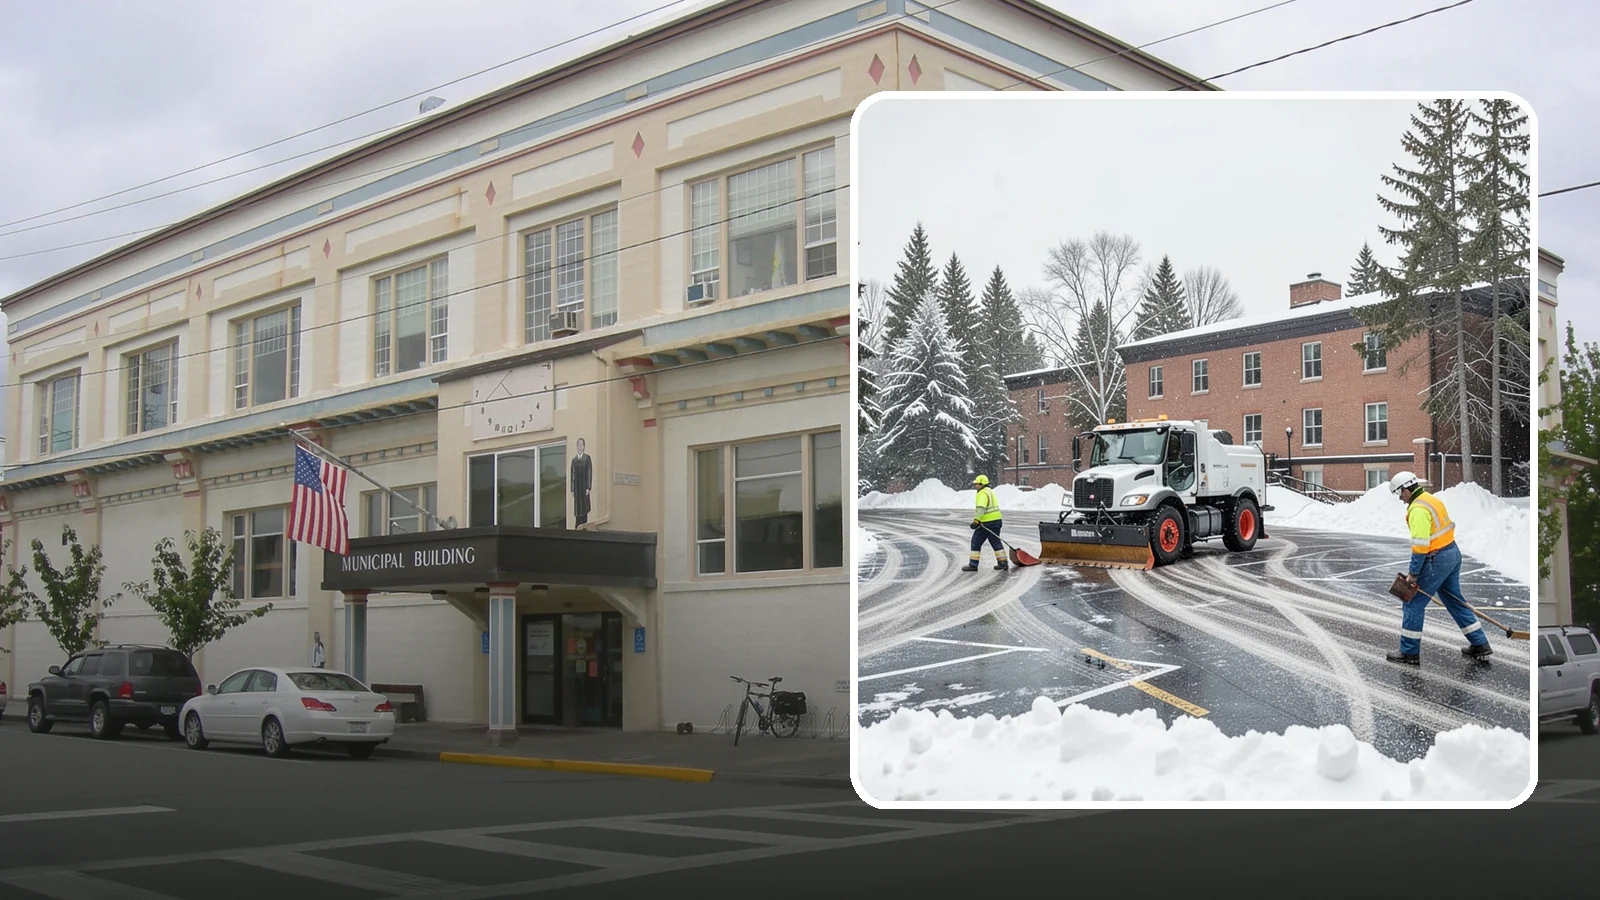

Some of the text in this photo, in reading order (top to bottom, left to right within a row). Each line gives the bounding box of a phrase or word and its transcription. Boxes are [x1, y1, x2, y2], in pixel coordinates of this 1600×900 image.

[480, 407, 485, 415] 8
[488, 418, 492, 426] 9
[494, 423, 500, 432] 10
[501, 425, 506, 433] 11
[507, 425, 513, 433] 12
[521, 420, 525, 428] 2
[529, 414, 533, 422] 3
[536, 402, 540, 410] 4
[342, 546, 475, 571] MUNICIPAL BUILDING
